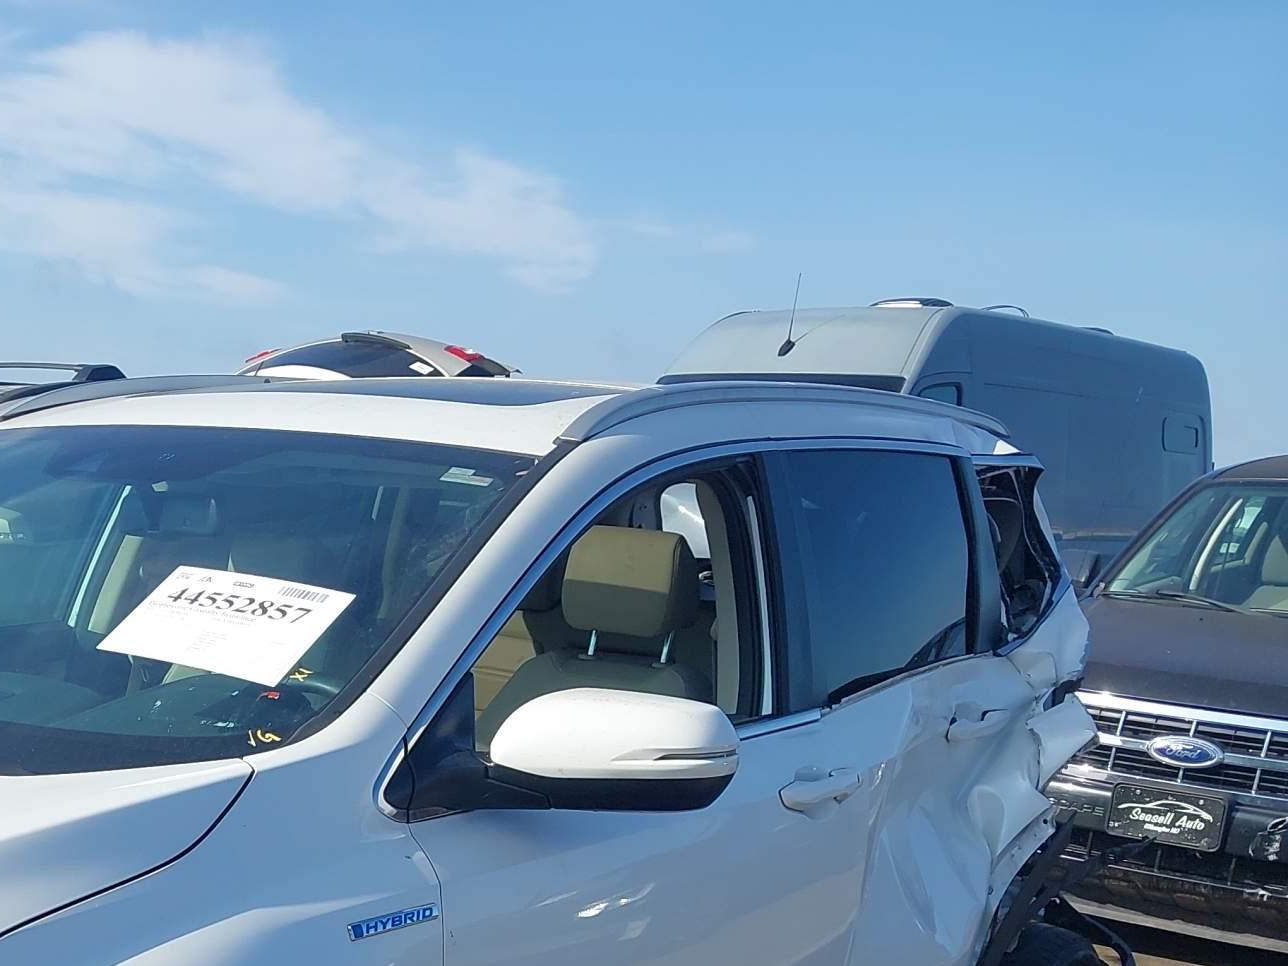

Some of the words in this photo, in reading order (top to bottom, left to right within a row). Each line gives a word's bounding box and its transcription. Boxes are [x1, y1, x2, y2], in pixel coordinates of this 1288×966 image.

[167, 587, 312, 624] 44552857
[1165, 743, 1202, 760] Ford
[1175, 815, 1206, 831] Auto
[365, 906, 433, 935] HYBRID
